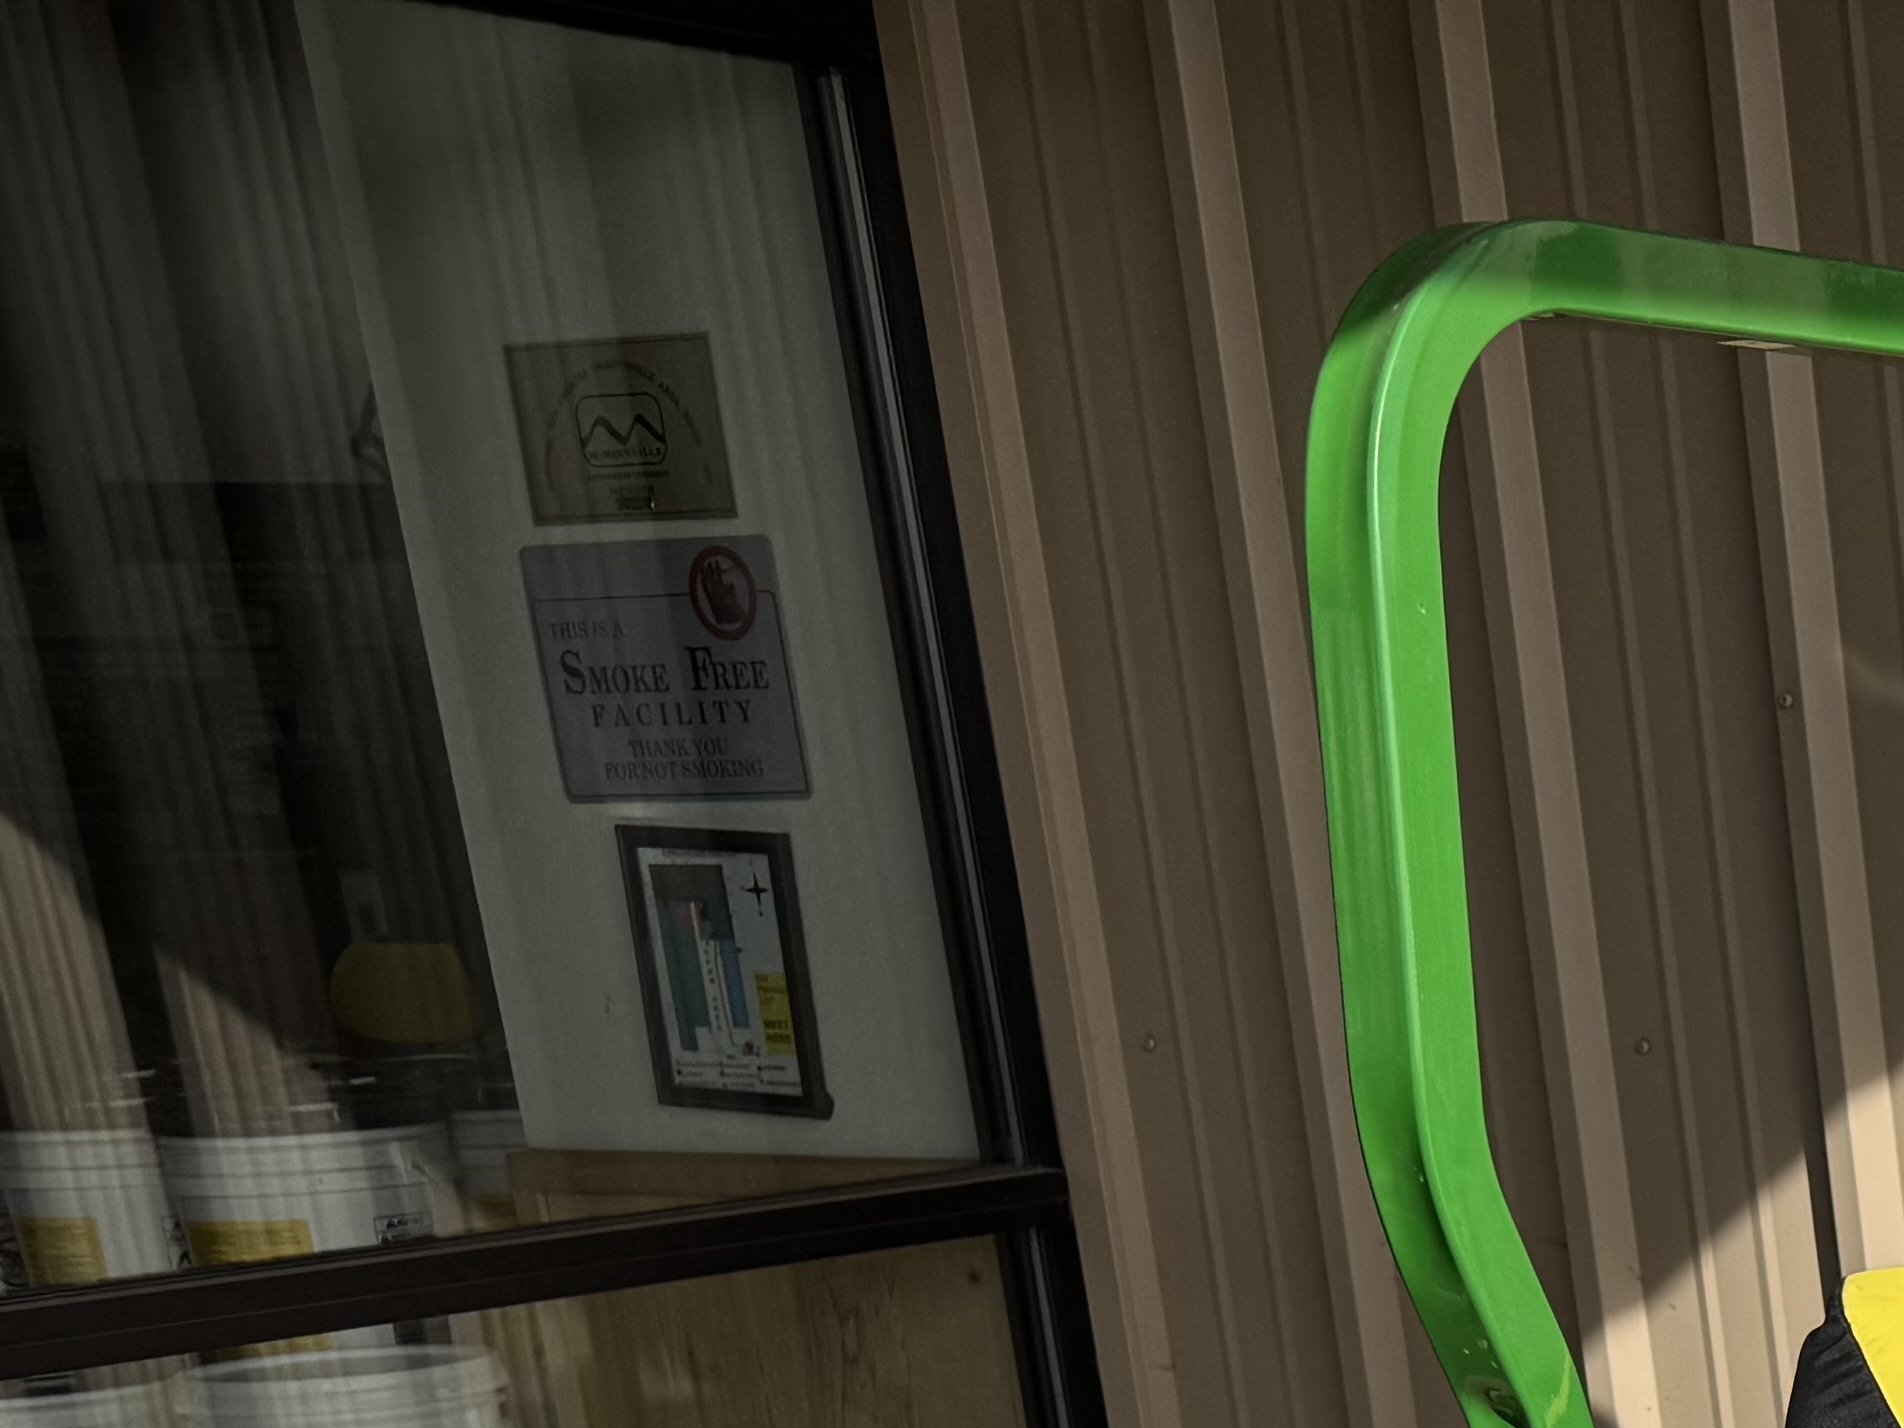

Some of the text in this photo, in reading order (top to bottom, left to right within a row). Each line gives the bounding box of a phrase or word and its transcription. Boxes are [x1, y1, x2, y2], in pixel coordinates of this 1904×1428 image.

[550, 619, 626, 640] THIS IS A
[559, 645, 770, 695] SMOKE FREE
[591, 699, 753, 728] FACILITY
[627, 736, 729, 759] THANK YOU
[604, 759, 765, 780] FOR NOT SMOKING
